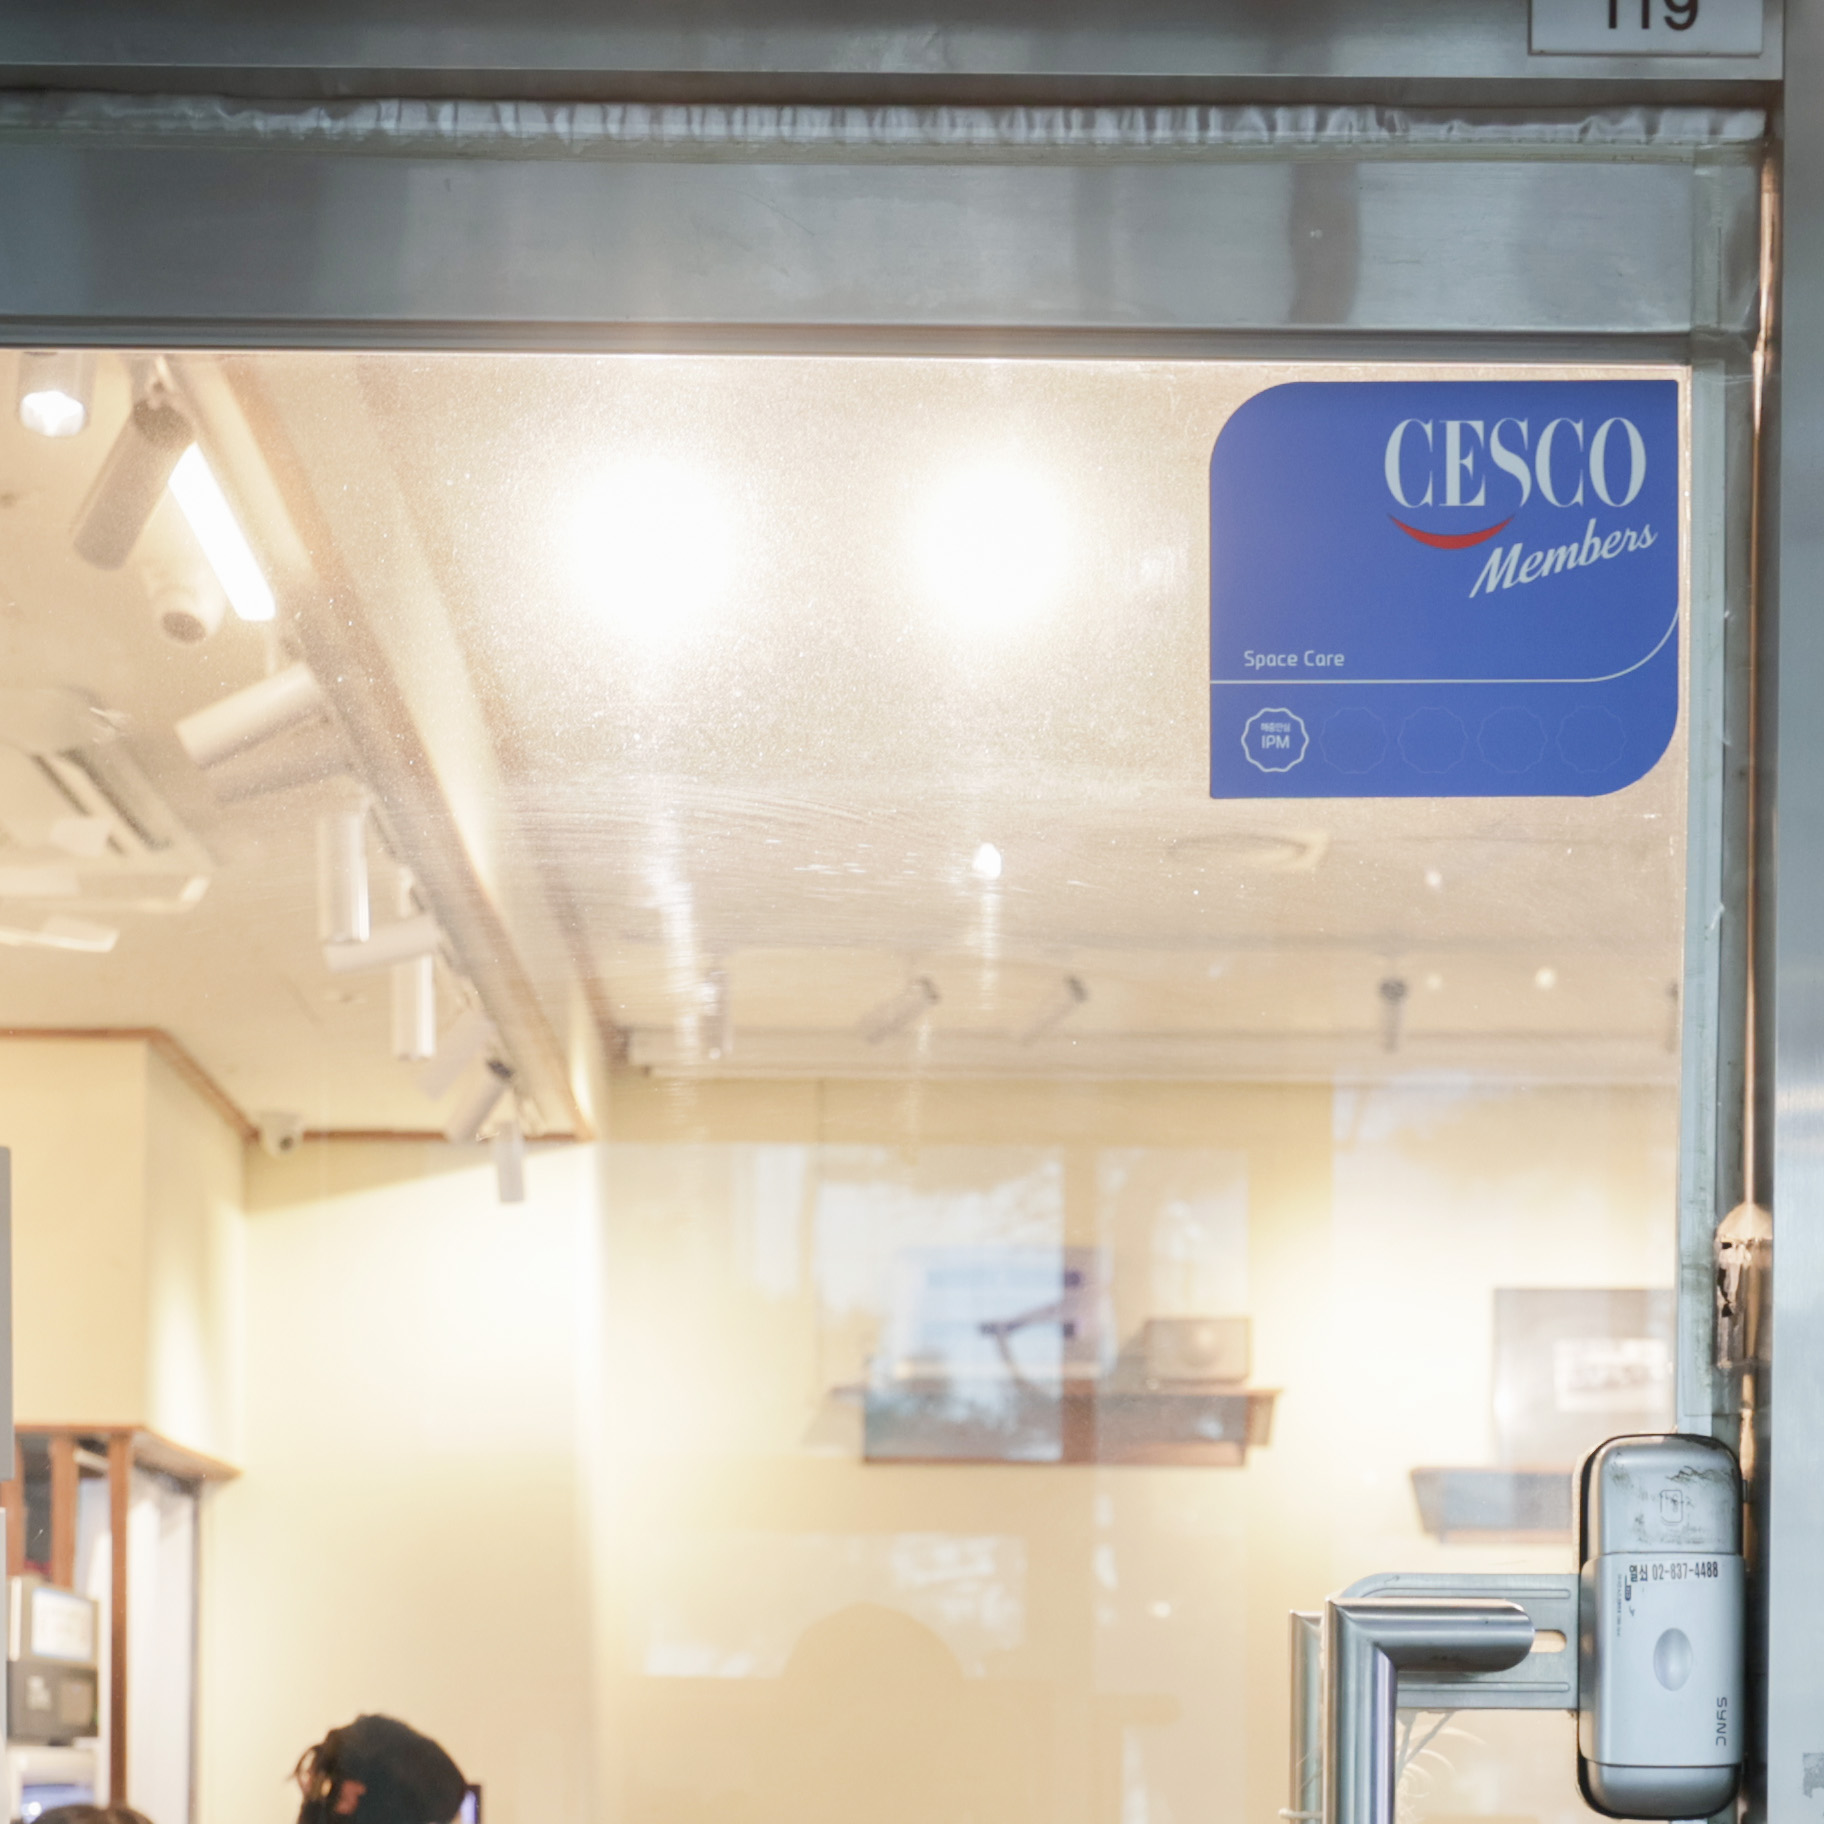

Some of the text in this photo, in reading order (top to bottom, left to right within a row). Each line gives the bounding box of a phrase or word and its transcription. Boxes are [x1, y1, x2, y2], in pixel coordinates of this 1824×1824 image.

[1384, 417, 1648, 509] CESCO
[1468, 517, 1659, 599] Members
[1243, 650, 1345, 670] Space Care
[1261, 735, 1291, 749] IPM
[1651, 1561, 1719, 1581] 02-837-4488
[1716, 1696, 1728, 1746] SYNC
